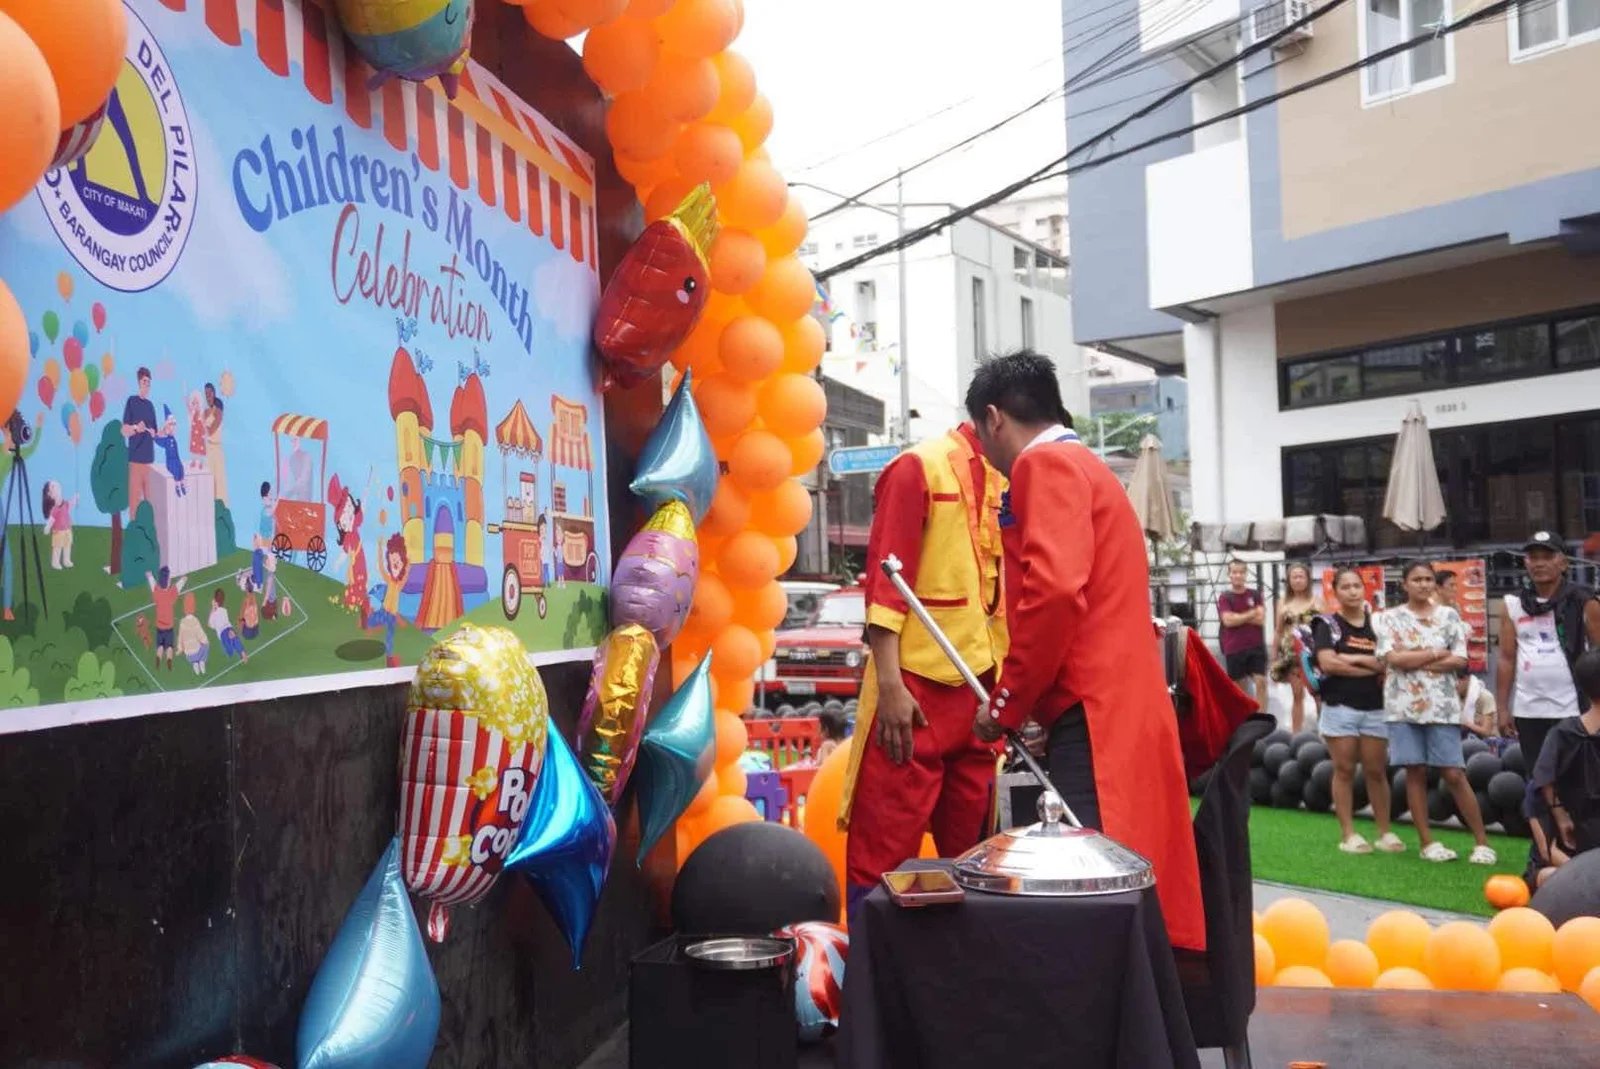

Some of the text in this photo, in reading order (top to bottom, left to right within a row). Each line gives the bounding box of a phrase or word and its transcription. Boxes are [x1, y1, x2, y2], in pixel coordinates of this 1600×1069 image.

[138, 39, 190, 234] DEL PILAR
[60, 202, 173, 273] BARANGAY COUNCIL
[82, 187, 148, 219] CITY OF MAKATI
[232, 124, 533, 354] Children's Month
[331, 203, 493, 343] Celebration
[499, 768, 528, 822] PO
[472, 825, 519, 864] COR
